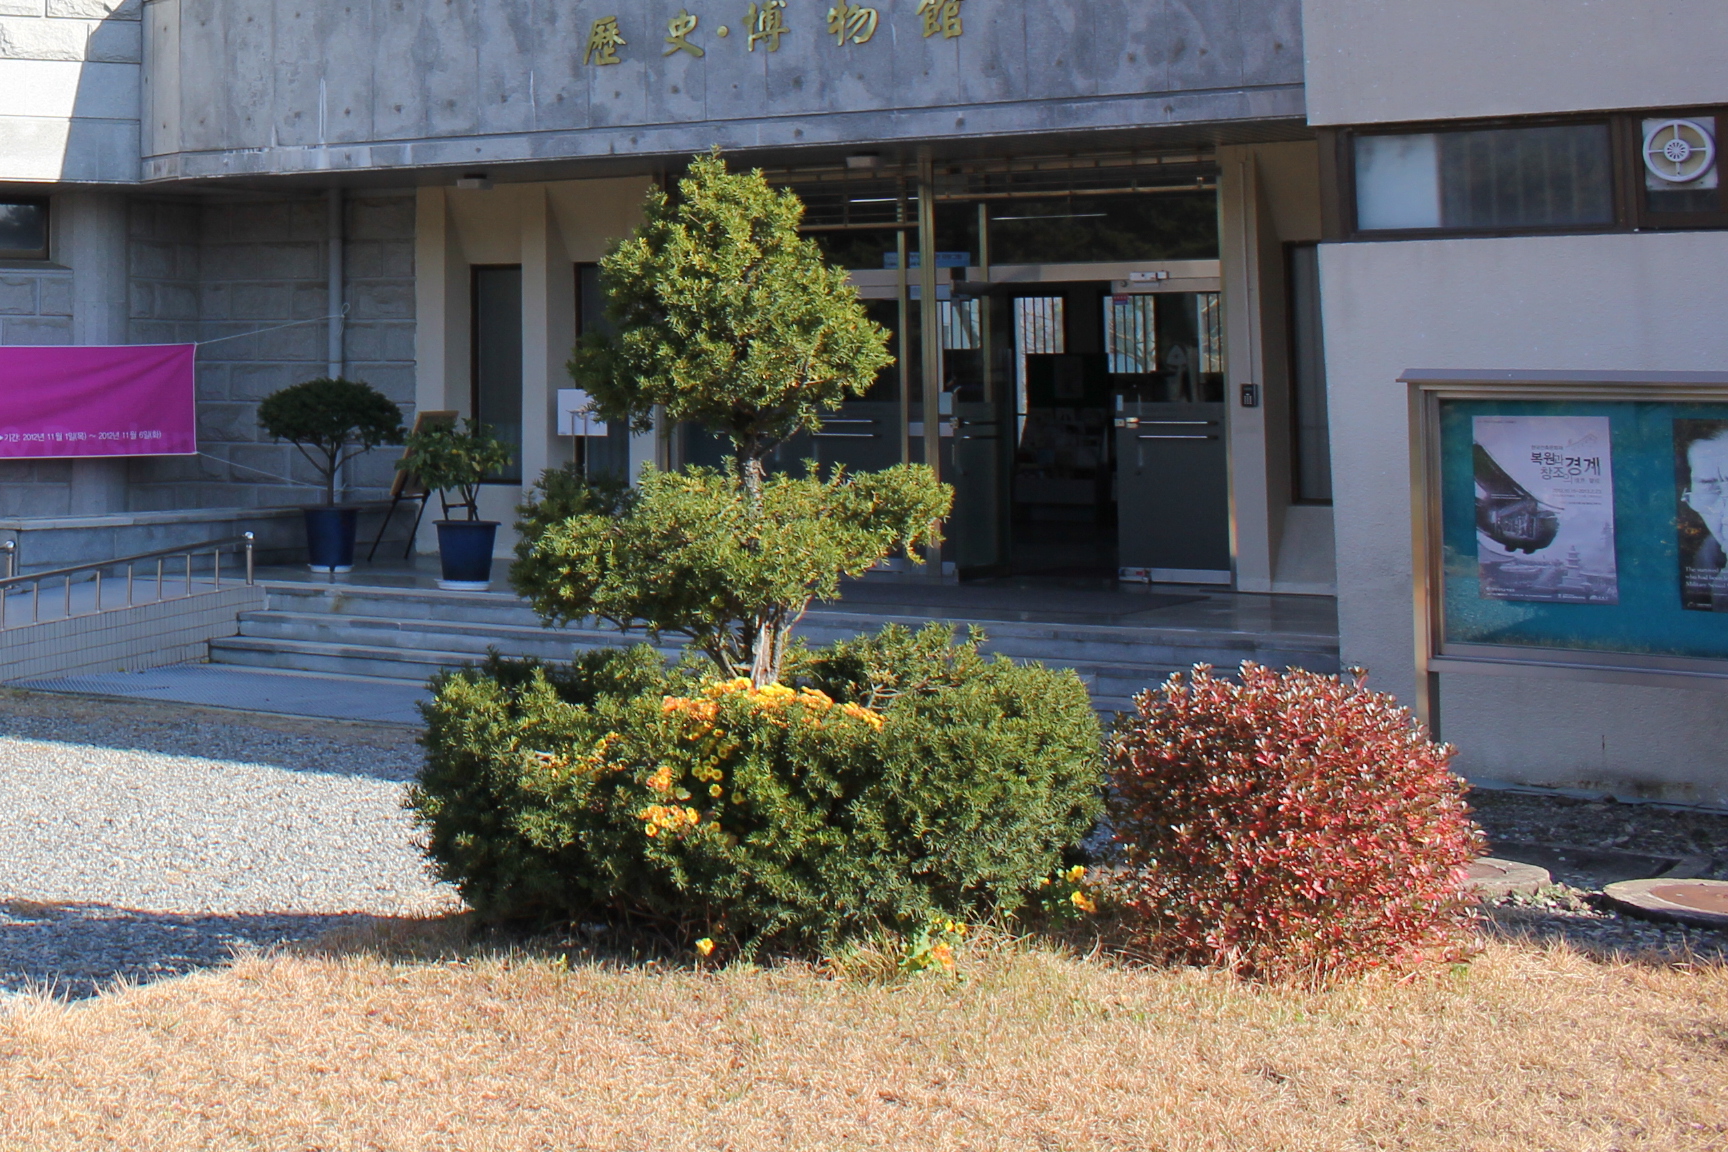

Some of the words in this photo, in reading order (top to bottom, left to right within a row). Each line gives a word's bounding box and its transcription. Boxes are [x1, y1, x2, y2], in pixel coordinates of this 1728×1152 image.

[22, 433, 45, 442] 2012년
[47, 432, 63, 441] 11월
[98, 431, 120, 440] 2012년
[122, 430, 137, 440] 11월
[1564, 456, 1601, 477] 경계
